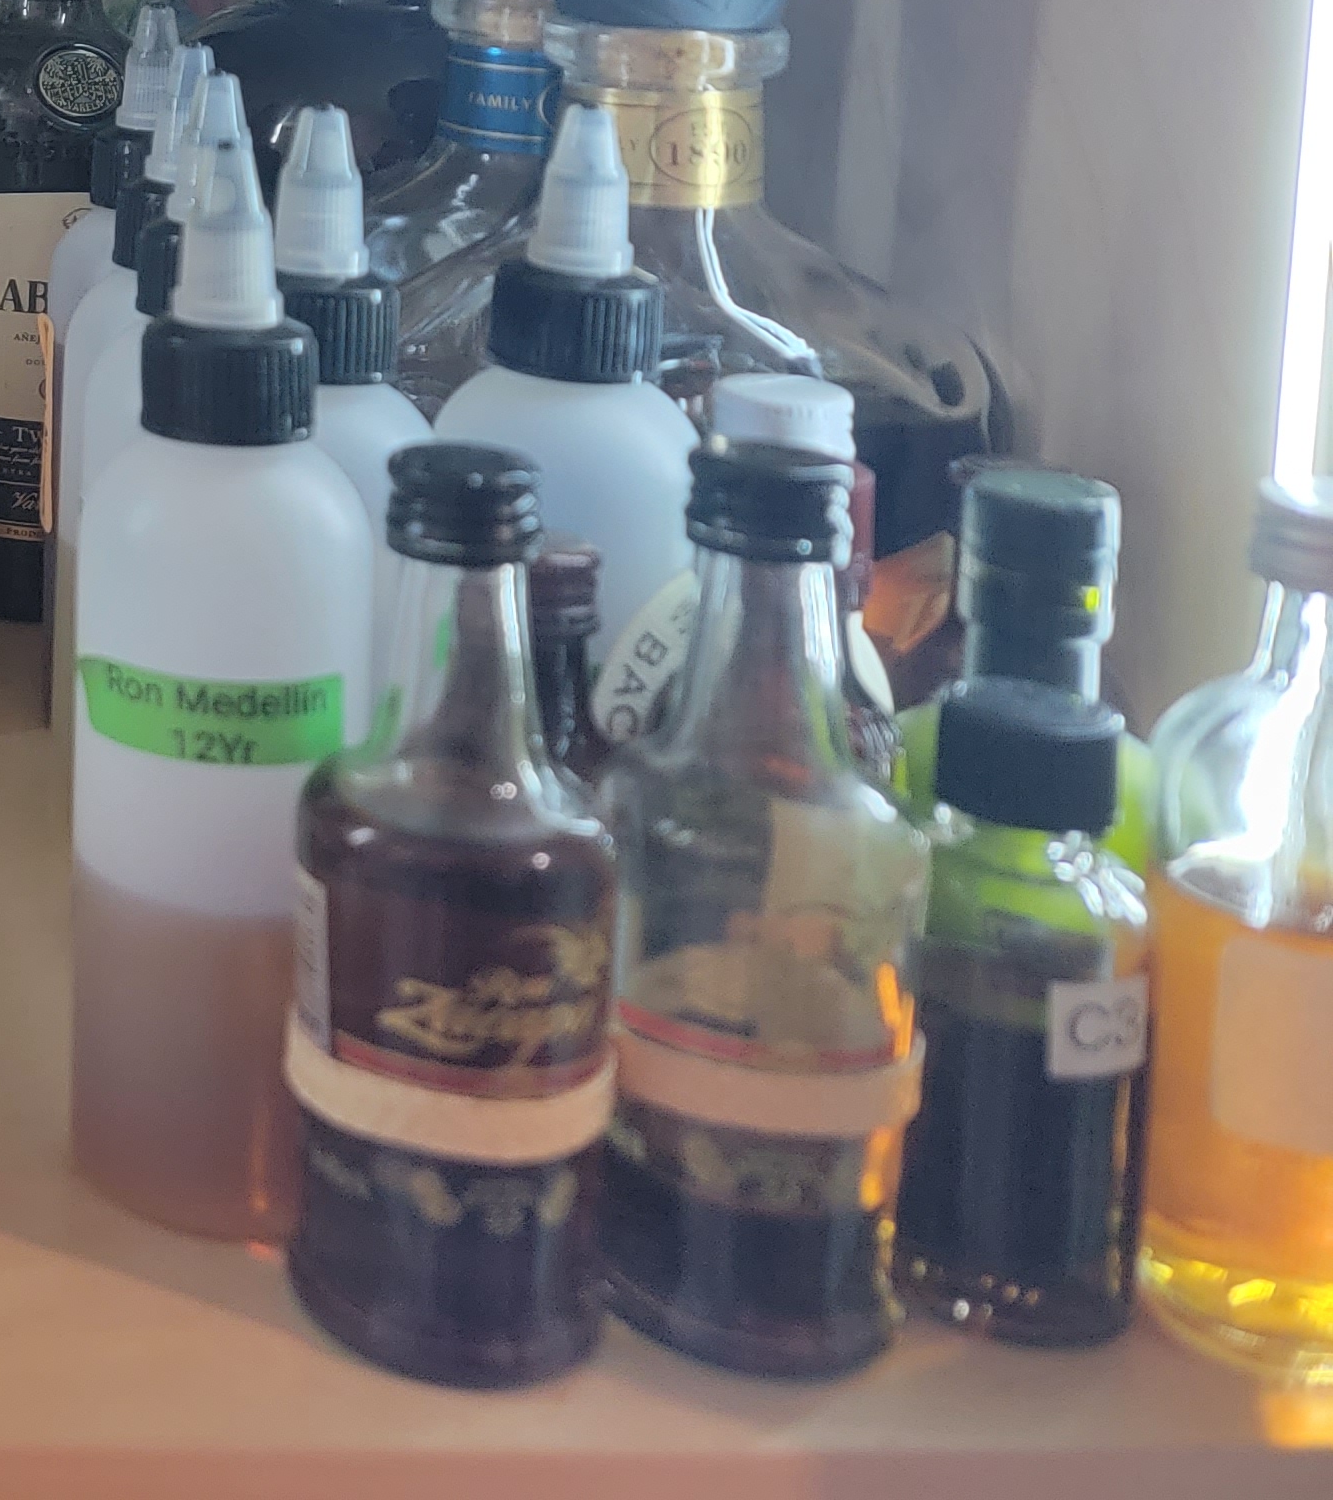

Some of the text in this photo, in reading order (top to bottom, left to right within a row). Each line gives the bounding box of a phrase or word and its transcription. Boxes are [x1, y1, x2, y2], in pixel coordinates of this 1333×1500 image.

[468, 91, 532, 112] FAMILY
[13, 331, 40, 345] AÑEJ
[106, 662, 165, 708] Ron
[170, 726, 260, 764] 12Yr
